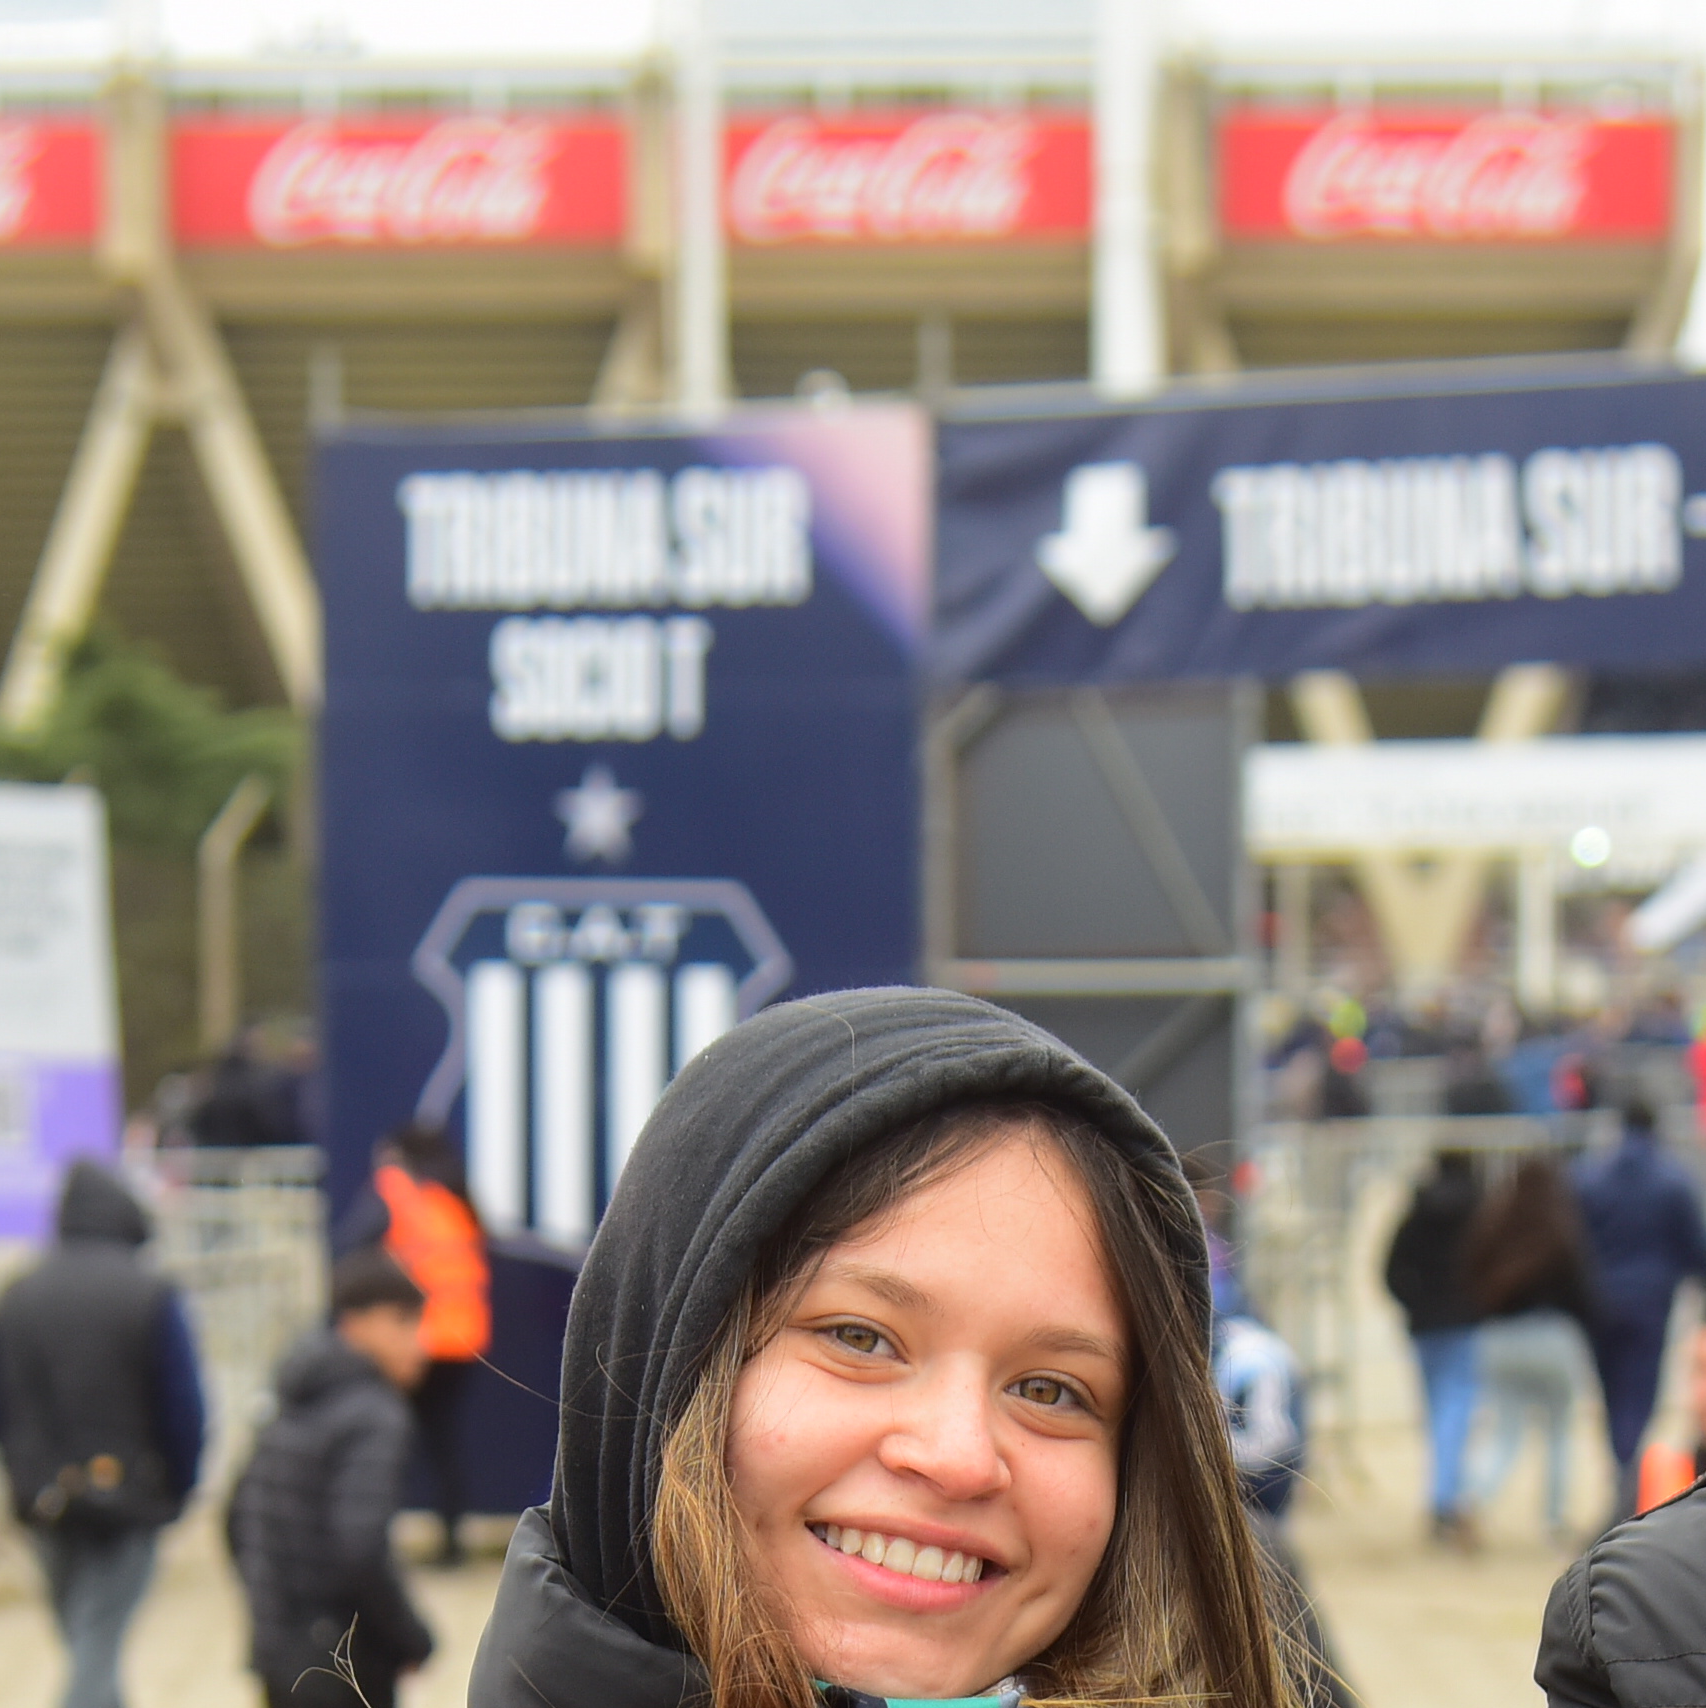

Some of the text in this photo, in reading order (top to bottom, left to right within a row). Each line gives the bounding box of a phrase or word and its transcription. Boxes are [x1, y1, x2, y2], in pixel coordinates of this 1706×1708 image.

[247, 114, 559, 246] Coca-Cola
[729, 112, 1041, 243] Coca-Cola
[1281, 110, 1597, 241] Coca-Cola
[1211, 456, 1519, 612] TRIBUNA
[1521, 442, 1683, 597] SUR
